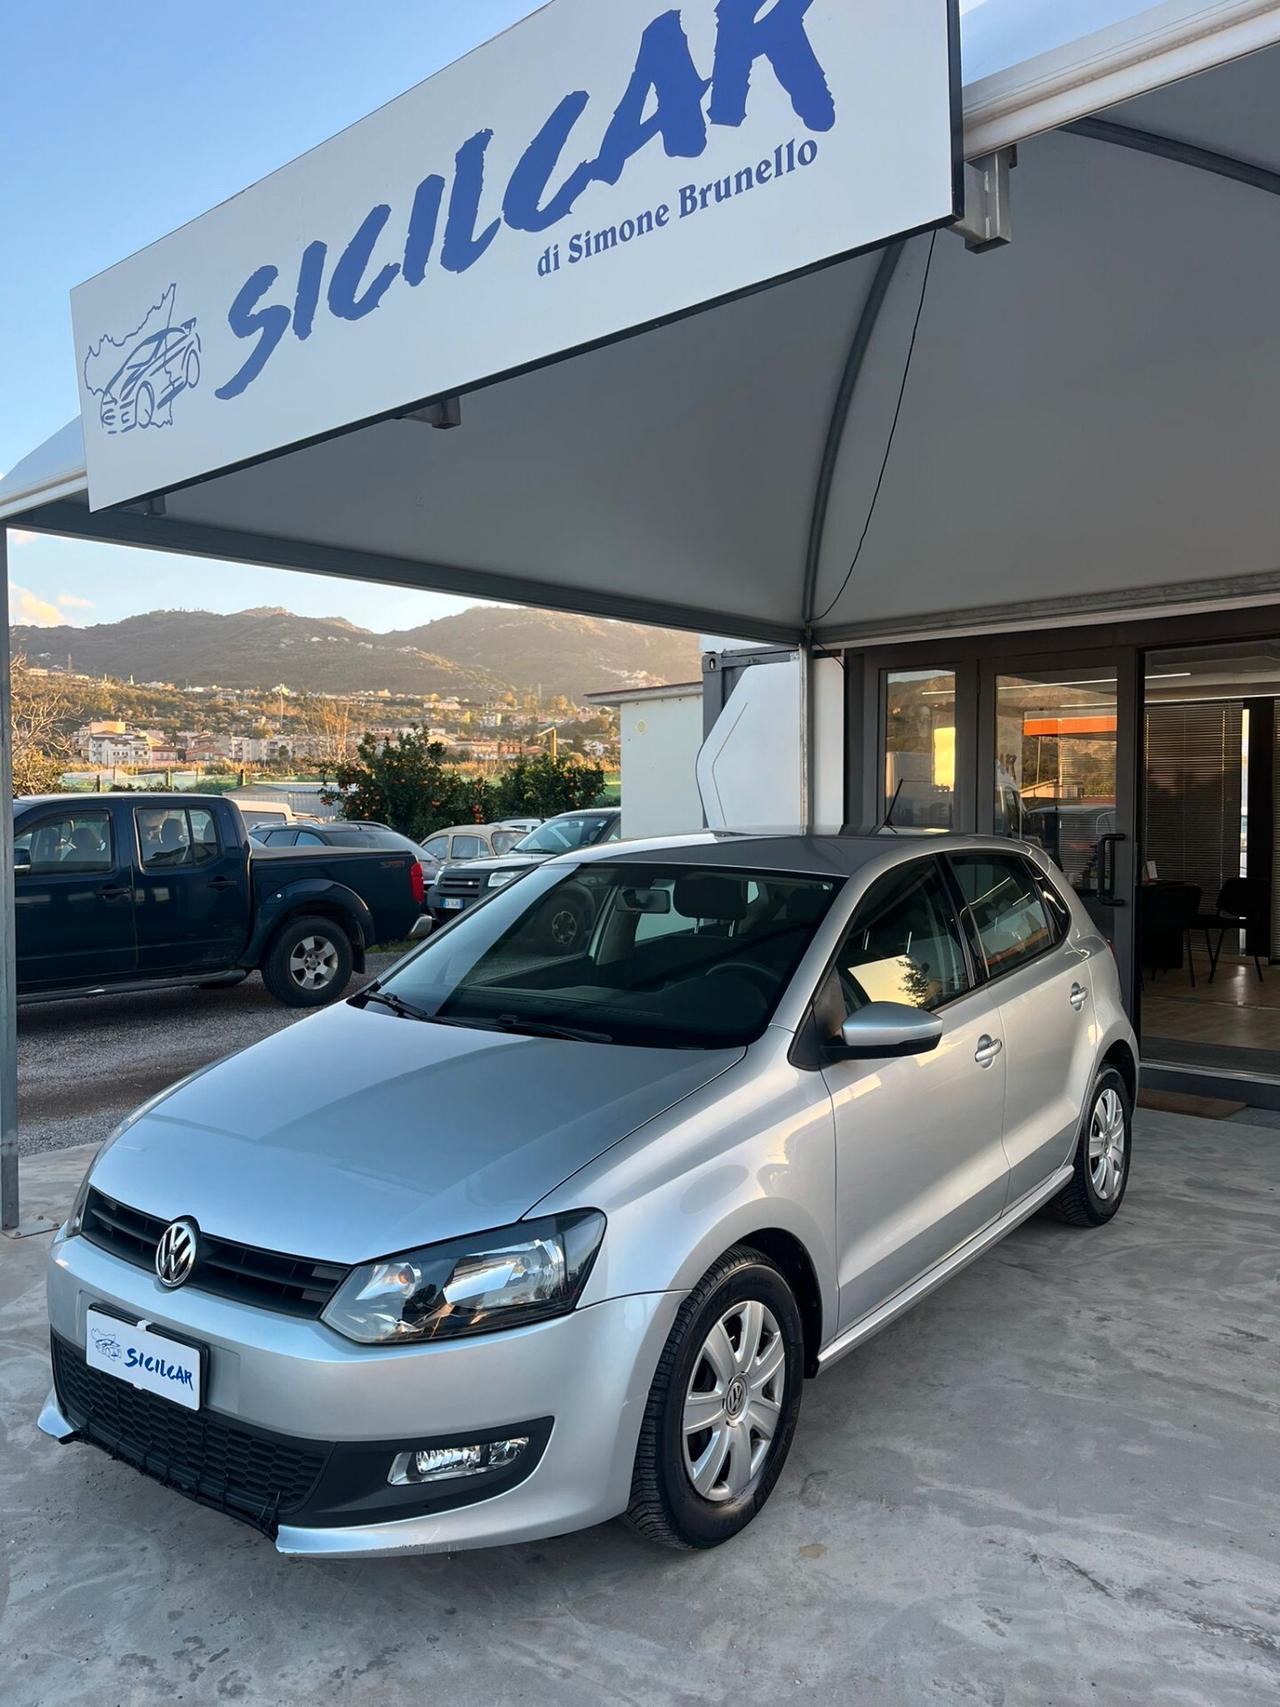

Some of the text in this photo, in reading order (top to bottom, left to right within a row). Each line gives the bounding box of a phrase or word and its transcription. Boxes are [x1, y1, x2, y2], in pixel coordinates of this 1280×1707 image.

[215, 0, 836, 401] SICILCAR
[536, 138, 818, 278] di Simone Brunello
[124, 1347, 194, 1391] SICILCAR
